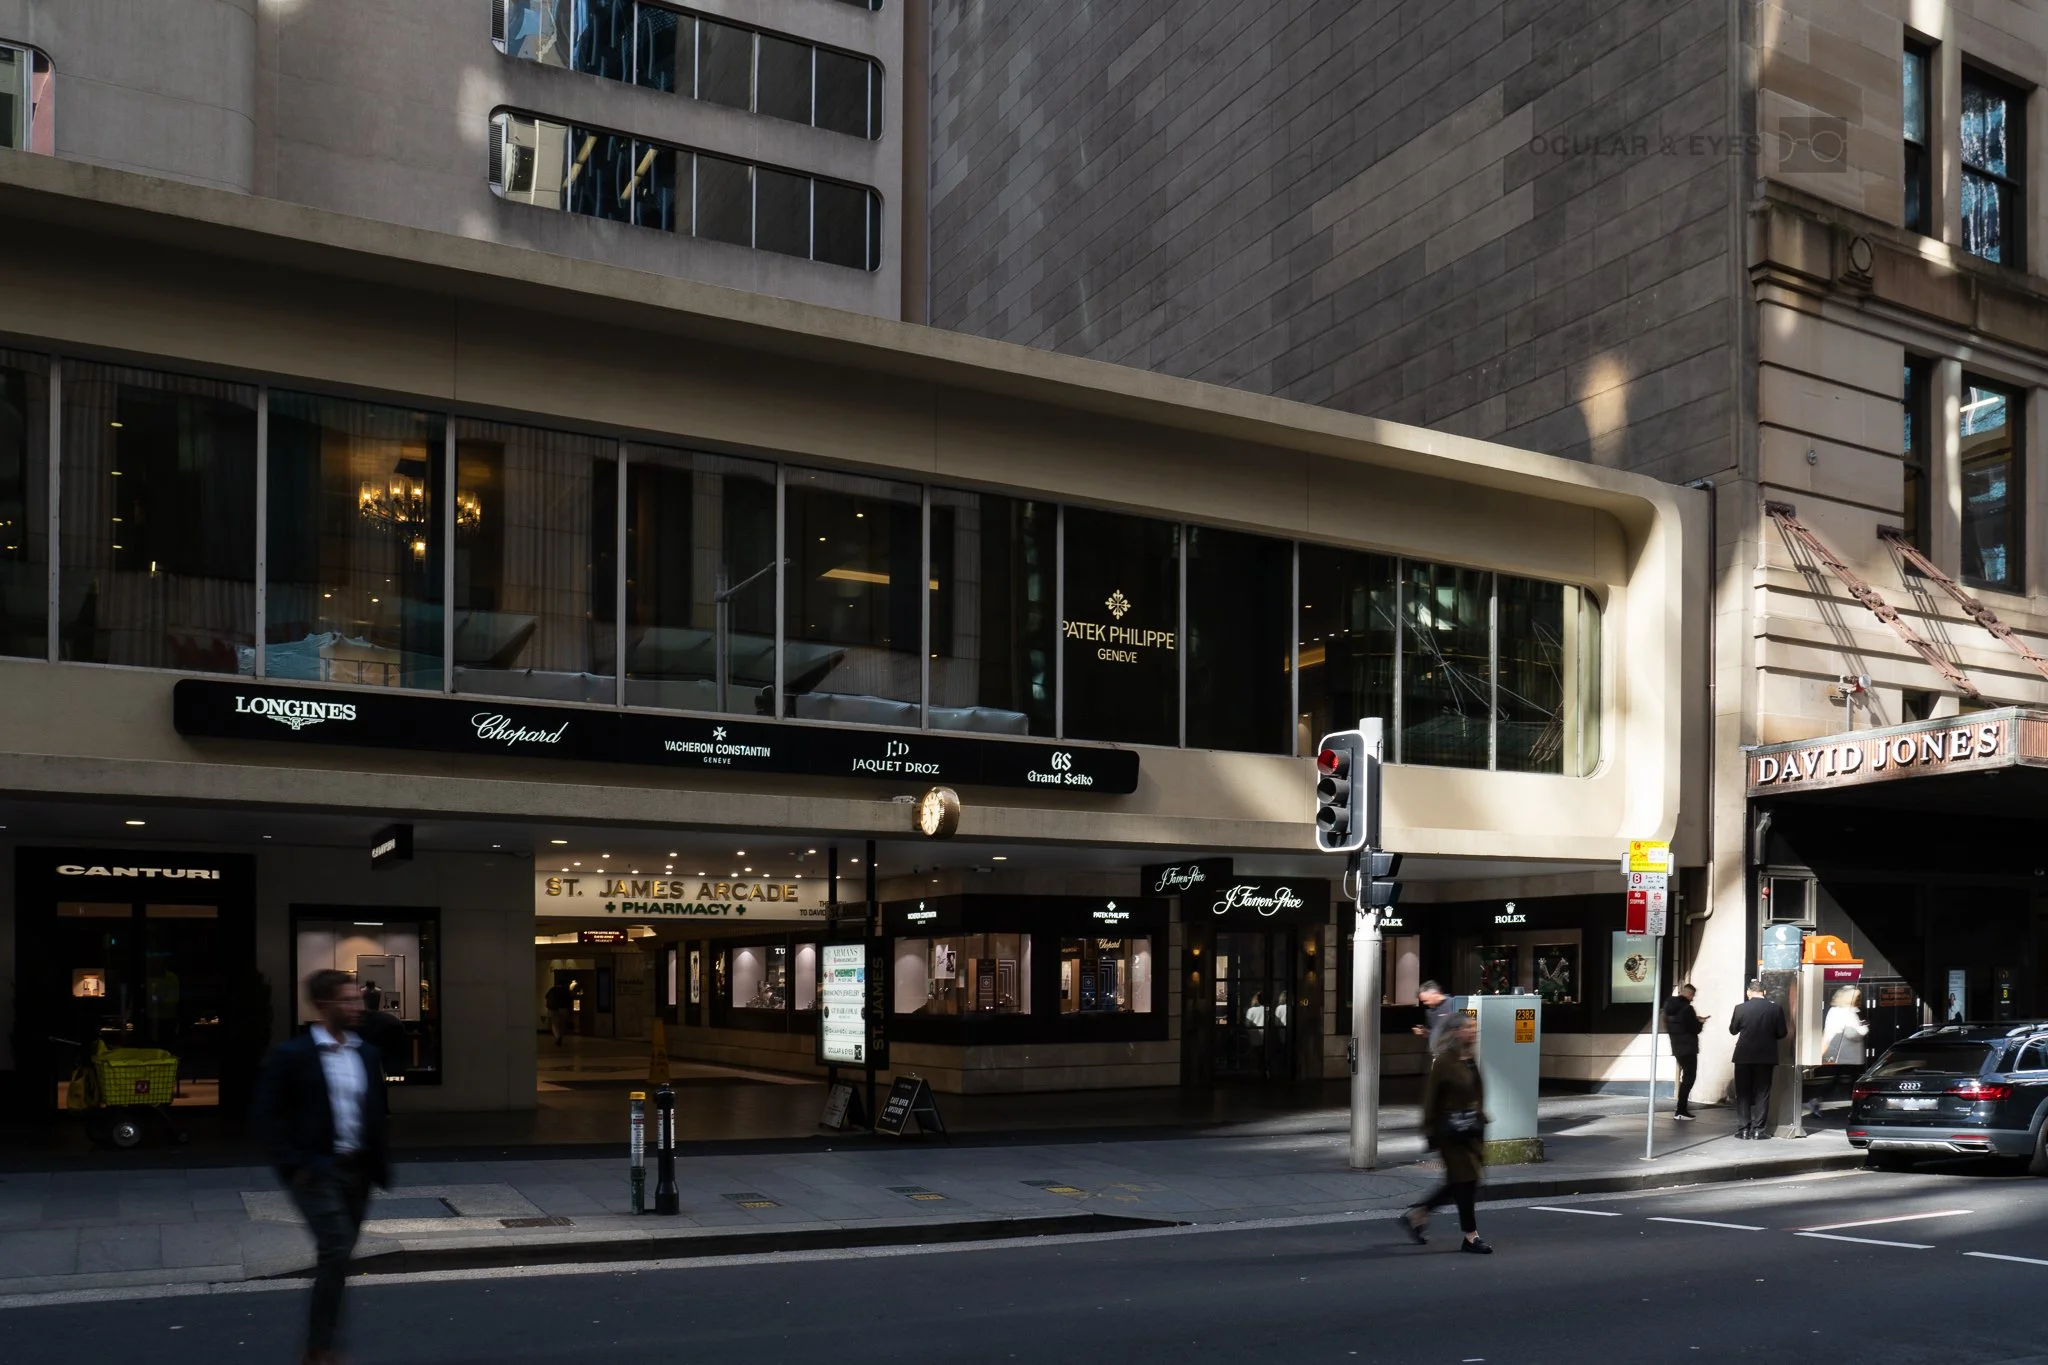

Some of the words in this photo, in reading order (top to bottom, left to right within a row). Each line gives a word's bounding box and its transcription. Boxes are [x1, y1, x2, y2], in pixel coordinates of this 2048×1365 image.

[1109, 625, 1175, 650] PHILIPPE
[1097, 648, 1138, 664] GENEVE
[235, 696, 357, 721] LONGINES
[471, 712, 569, 746] Chopard
[664, 740, 714, 754] VACHERON
[715, 744, 771, 757] CONSTANTIN
[1758, 745, 1863, 785] DAVID
[1873, 724, 2000, 770] JONES
[852, 758, 902, 773] JAQUET
[905, 762, 940, 774] DROZ
[1051, 751, 1072, 771] GS
[1027, 770, 1061, 784] Grand
[1064, 772, 1093, 786] Seiko
[56, 864, 220, 879] CANTURI
[545, 877, 583, 897] ST.
[599, 879, 684, 900] JAMES
[696, 882, 799, 903] ARCADE
[622, 901, 731, 915] PHARMACY
[1380, 918, 1403, 927] OLEX
[1494, 915, 1526, 924] ROLEX
[774, 947, 786, 955] TU
[834, 968, 857, 978] CHEMIST
[1834, 970, 1852, 978] Telstra
[872, 956, 885, 1020] JAMES
[1516, 1010, 1534, 1020] 2382
[872, 1023, 885, 1052] ST.
